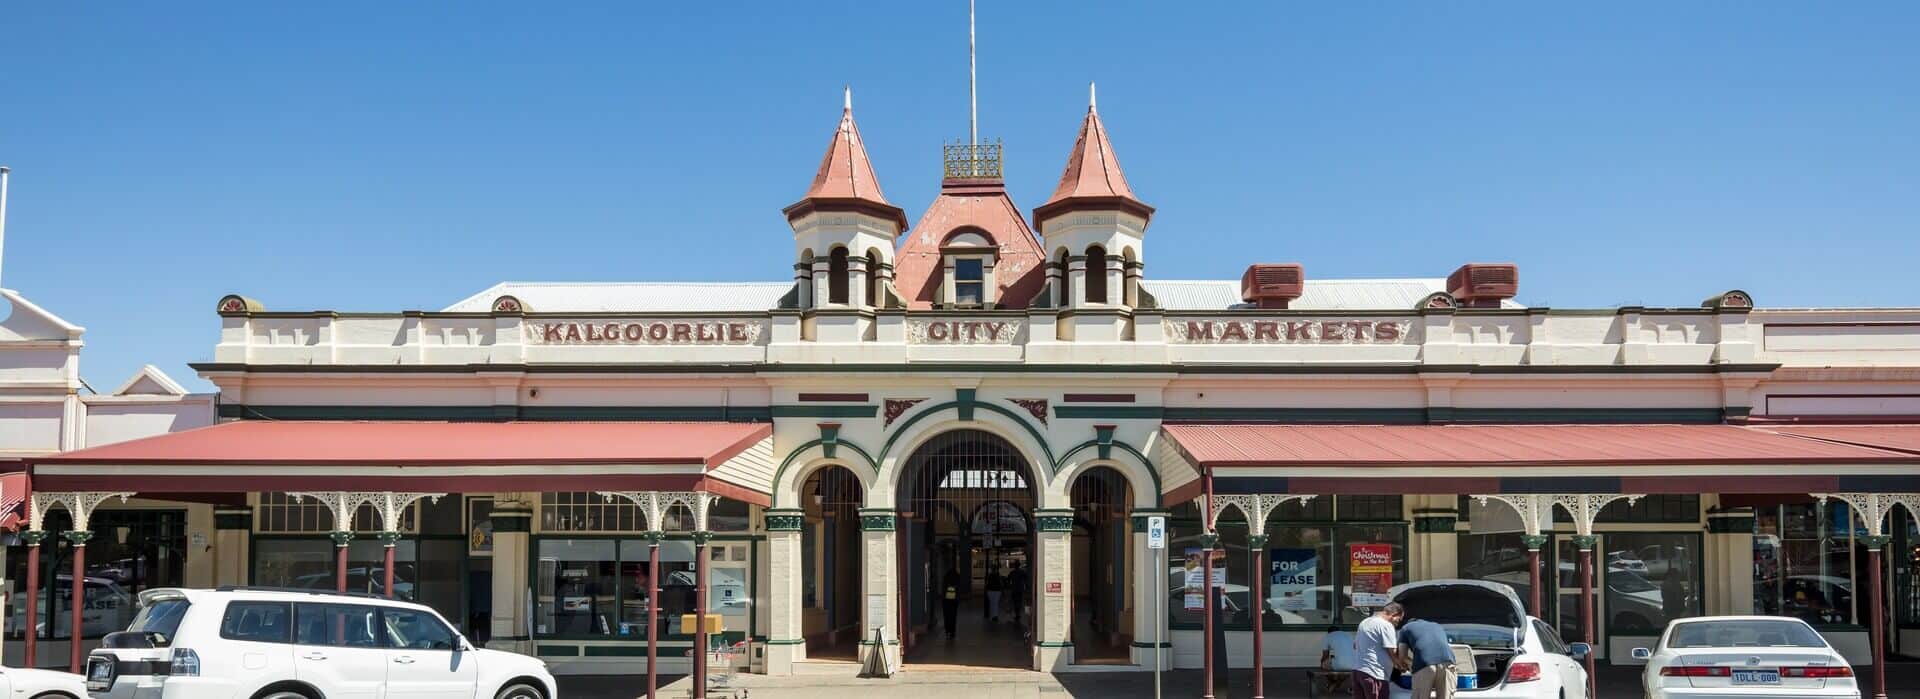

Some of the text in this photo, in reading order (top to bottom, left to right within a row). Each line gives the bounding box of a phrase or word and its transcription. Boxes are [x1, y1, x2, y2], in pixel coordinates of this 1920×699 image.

[543, 321, 1401, 341] KALGOORLIE CITY MARKETS
[1272, 561, 1298, 571] FOR
[1272, 575, 1315, 585] LEASE
